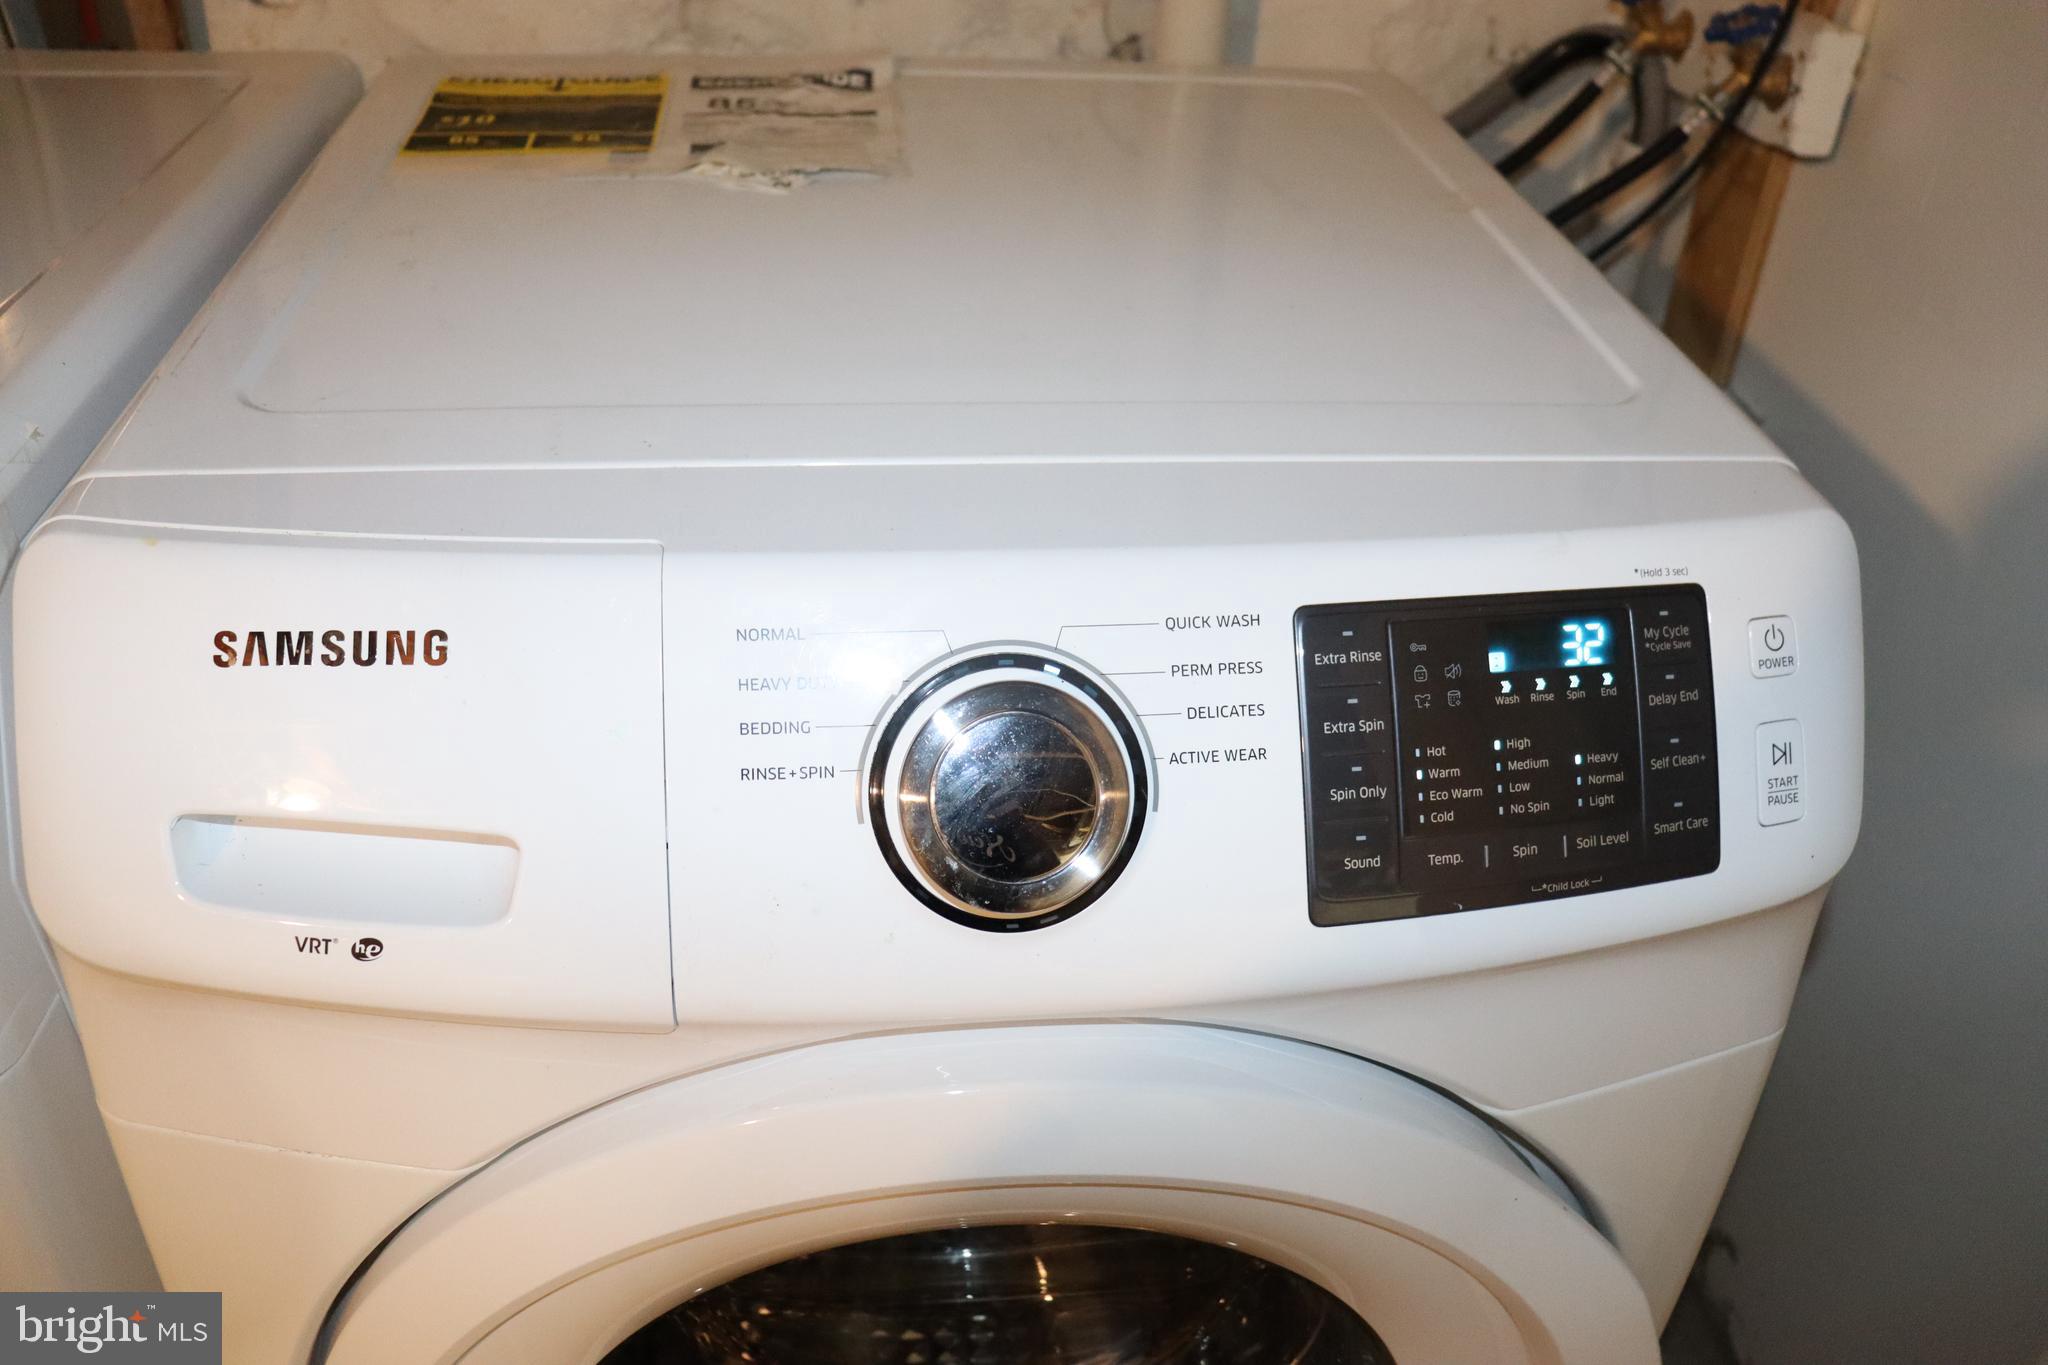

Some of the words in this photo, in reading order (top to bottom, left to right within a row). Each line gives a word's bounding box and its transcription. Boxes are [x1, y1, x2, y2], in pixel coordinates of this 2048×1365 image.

[1665, 568, 1670, 576] 3
[1672, 567, 1688, 576] sec)
[1166, 616, 1211, 631] QUICK
[1216, 614, 1260, 627] WASH
[736, 628, 805, 641] NORMAL
[1644, 628, 1659, 640] My
[1663, 625, 1689, 638] Cycle
[213, 630, 448, 668] SAMSUNG
[1561, 621, 1606, 667] 32
[1673, 641, 1691, 649] Save
[1315, 653, 1346, 665] Extra
[1350, 651, 1382, 663] Rinse
[1759, 656, 1794, 669] POWER
[1172, 664, 1212, 677] PERM
[1219, 661, 1262, 675] PRESS
[738, 678, 790, 691] HEAVY
[1531, 692, 1554, 702] Rinse
[1567, 690, 1585, 700] Spin
[1601, 687, 1617, 696] End
[1649, 693, 1677, 706] Delay
[1680, 689, 1698, 702] End
[1495, 694, 1519, 704] Wash
[1187, 704, 1265, 719] DELICATES
[740, 721, 810, 735] BEDDING
[1324, 722, 1355, 734] Extra
[1359, 719, 1384, 733] Spin
[1507, 737, 1530, 750] High
[1170, 750, 1219, 764] ACTIVE
[1225, 748, 1267, 761] WEAR
[1427, 746, 1446, 757] Hot
[1587, 752, 1618, 763] Heavy
[1508, 758, 1549, 771] Medium
[1651, 758, 1669, 770] Self
[1428, 768, 1460, 778] Warm
[1589, 772, 1624, 784] Normal
[1510, 782, 1530, 792] Low
[1768, 775, 1798, 789] START
[1330, 788, 1356, 802] Spin
[1360, 785, 1387, 799] Only
[1430, 790, 1448, 800] Eco
[1451, 788, 1482, 799] Warm
[1768, 792, 1799, 806] PAUSE
[1590, 794, 1614, 807] Light
[1511, 804, 1525, 814] No
[1528, 801, 1549, 813] Spin
[1431, 811, 1454, 822] Cold
[1654, 820, 1683, 834] Smart
[1687, 818, 1708, 829] Care
[1577, 835, 1596, 849] Soil
[1601, 832, 1629, 845] Level
[1513, 844, 1537, 858] Spin
[1344, 855, 1380, 870] Sound
[1428, 854, 1463, 866] Temp.
[1571, 879, 1589, 889] Lock
